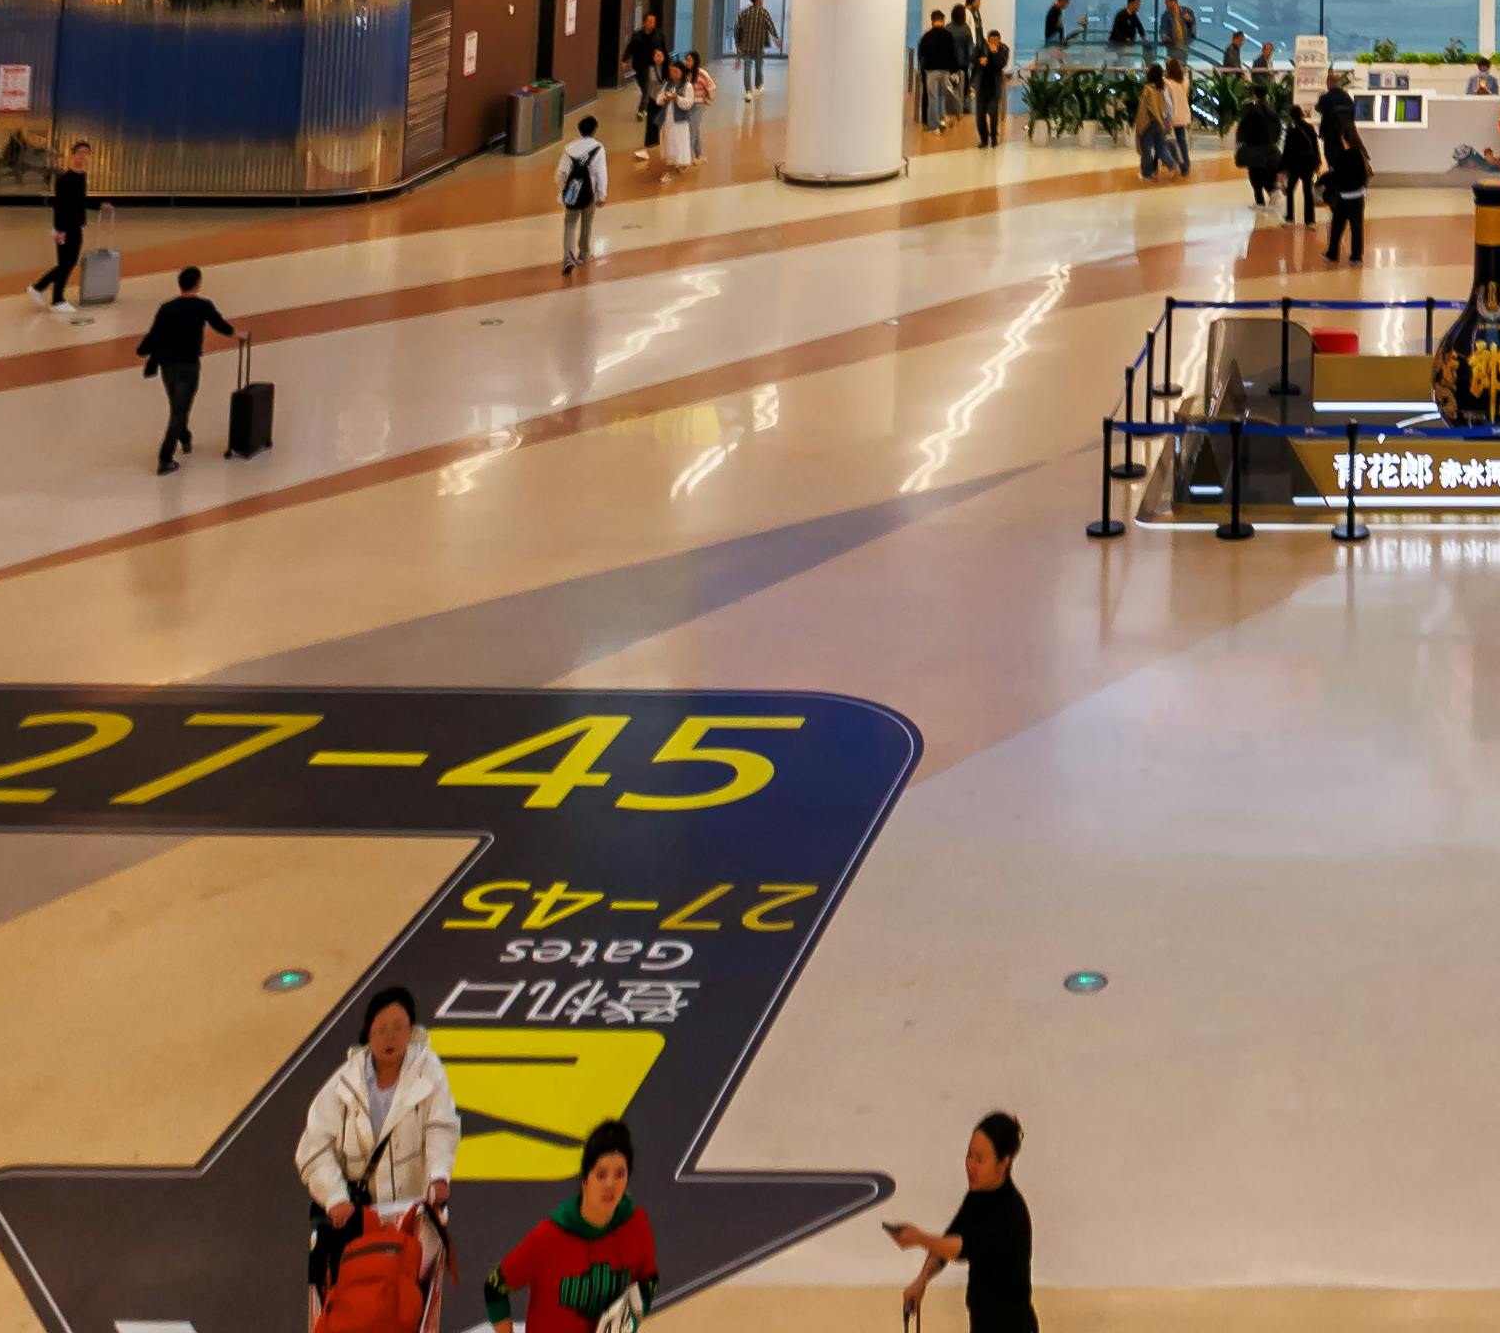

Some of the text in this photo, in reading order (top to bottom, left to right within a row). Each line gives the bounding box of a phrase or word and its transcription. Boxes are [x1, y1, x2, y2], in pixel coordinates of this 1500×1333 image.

[1332, 450, 1434, 490] 青花郎
[441, 878, 822, 933] 27-45
[498, 937, 696, 972] Gates
[433, 977, 702, 1026] 登机口
